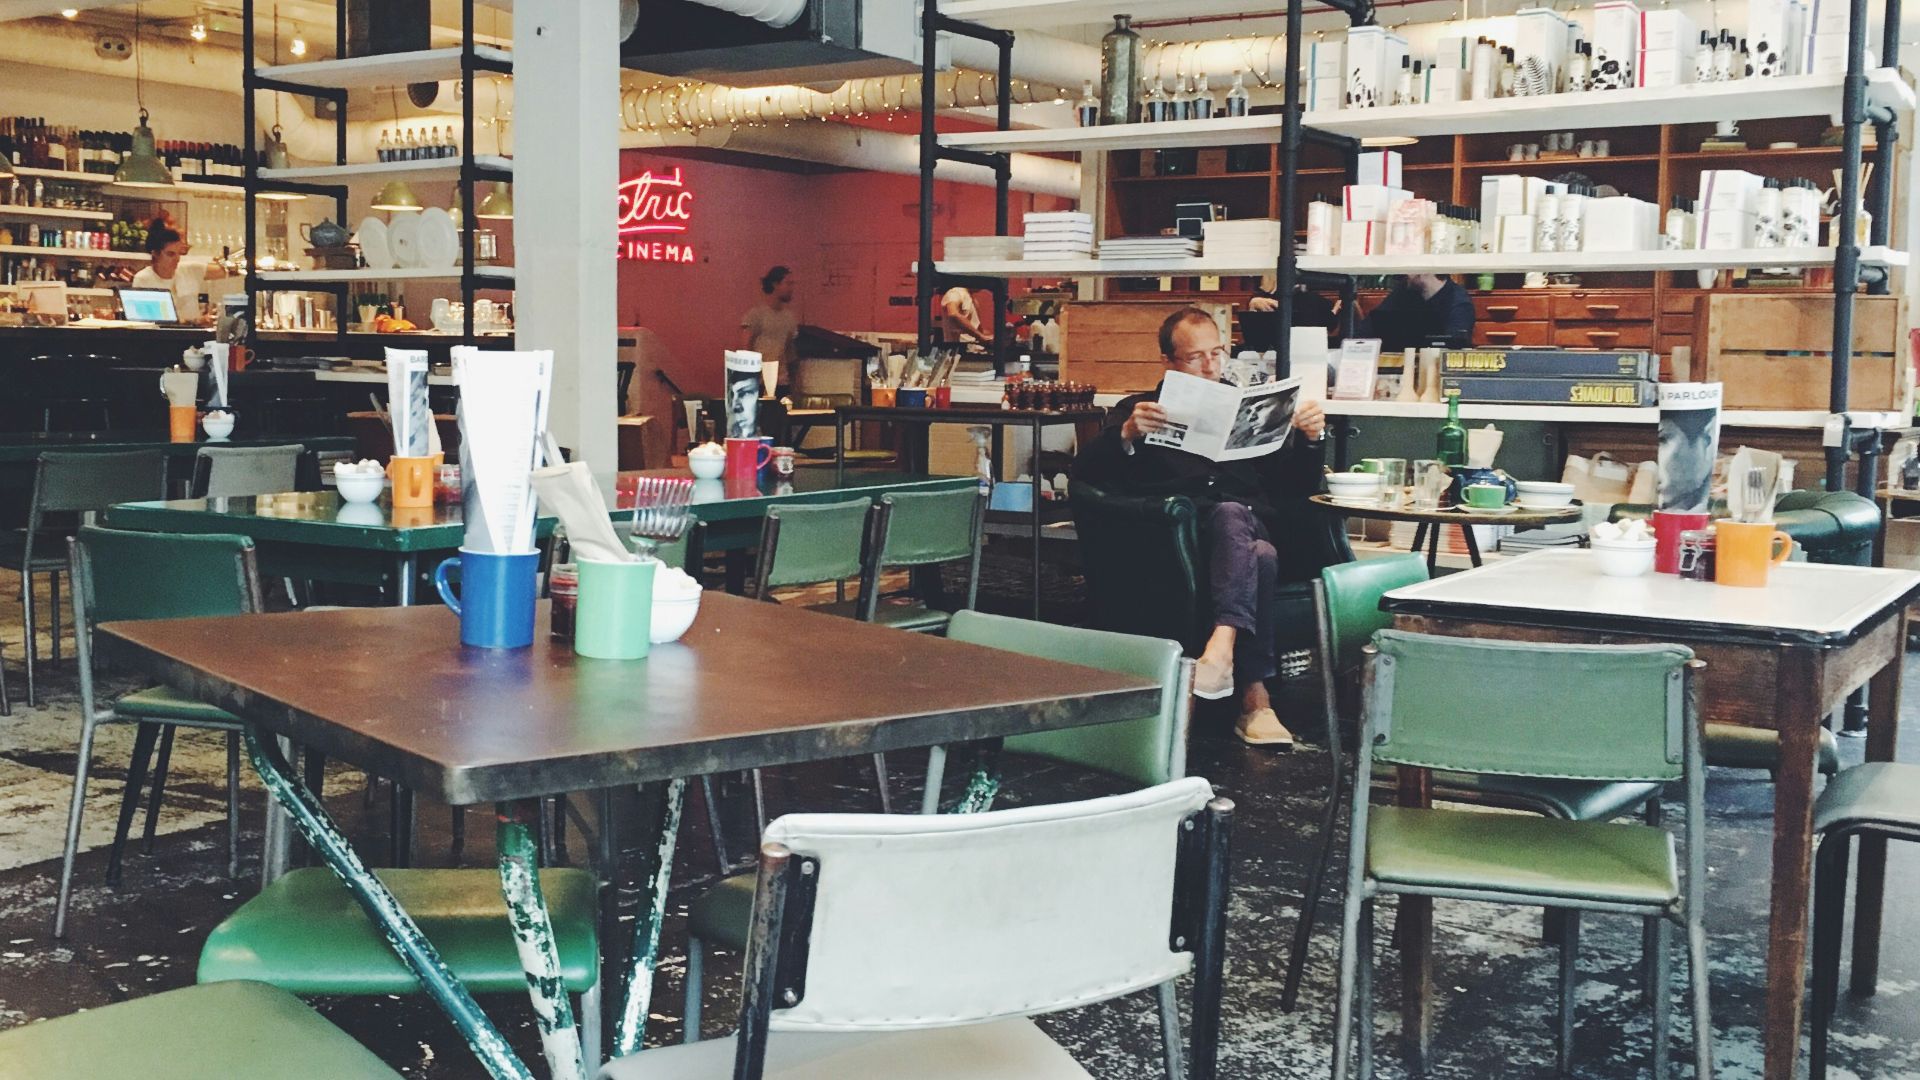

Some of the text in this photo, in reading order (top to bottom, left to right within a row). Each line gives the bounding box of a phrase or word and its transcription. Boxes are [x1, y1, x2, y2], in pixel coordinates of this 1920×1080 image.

[1446, 352, 1506, 369] 100 MOVIES
[1570, 385, 1613, 402] MOVIES
